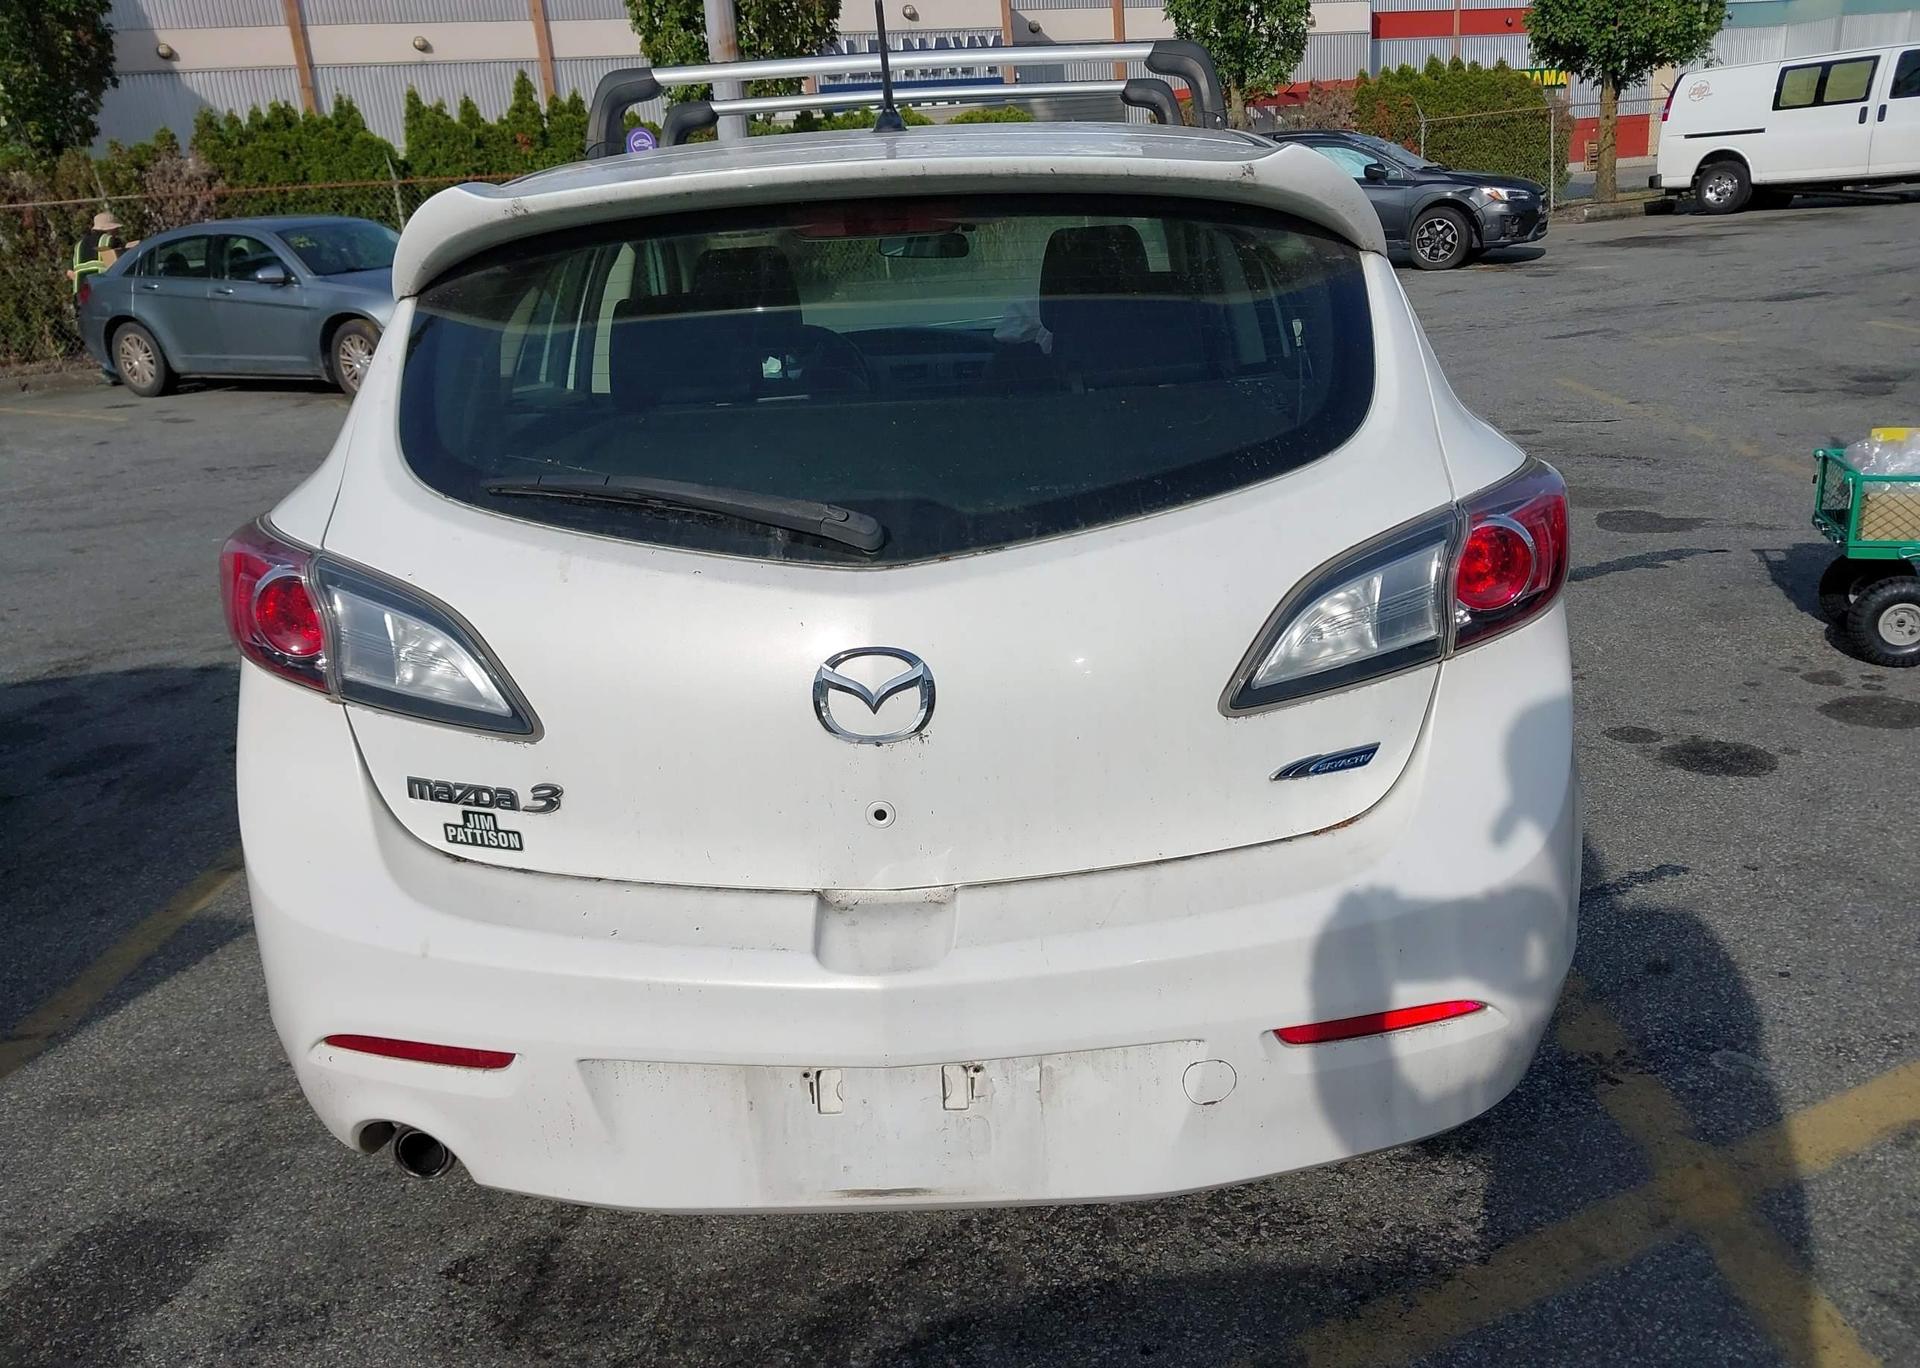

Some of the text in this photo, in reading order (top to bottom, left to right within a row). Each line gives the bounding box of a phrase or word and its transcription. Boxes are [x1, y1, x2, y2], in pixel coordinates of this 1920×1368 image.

[522, 782, 564, 814] 3
[466, 813, 495, 831] JIM
[447, 826, 521, 849] PATTISON
